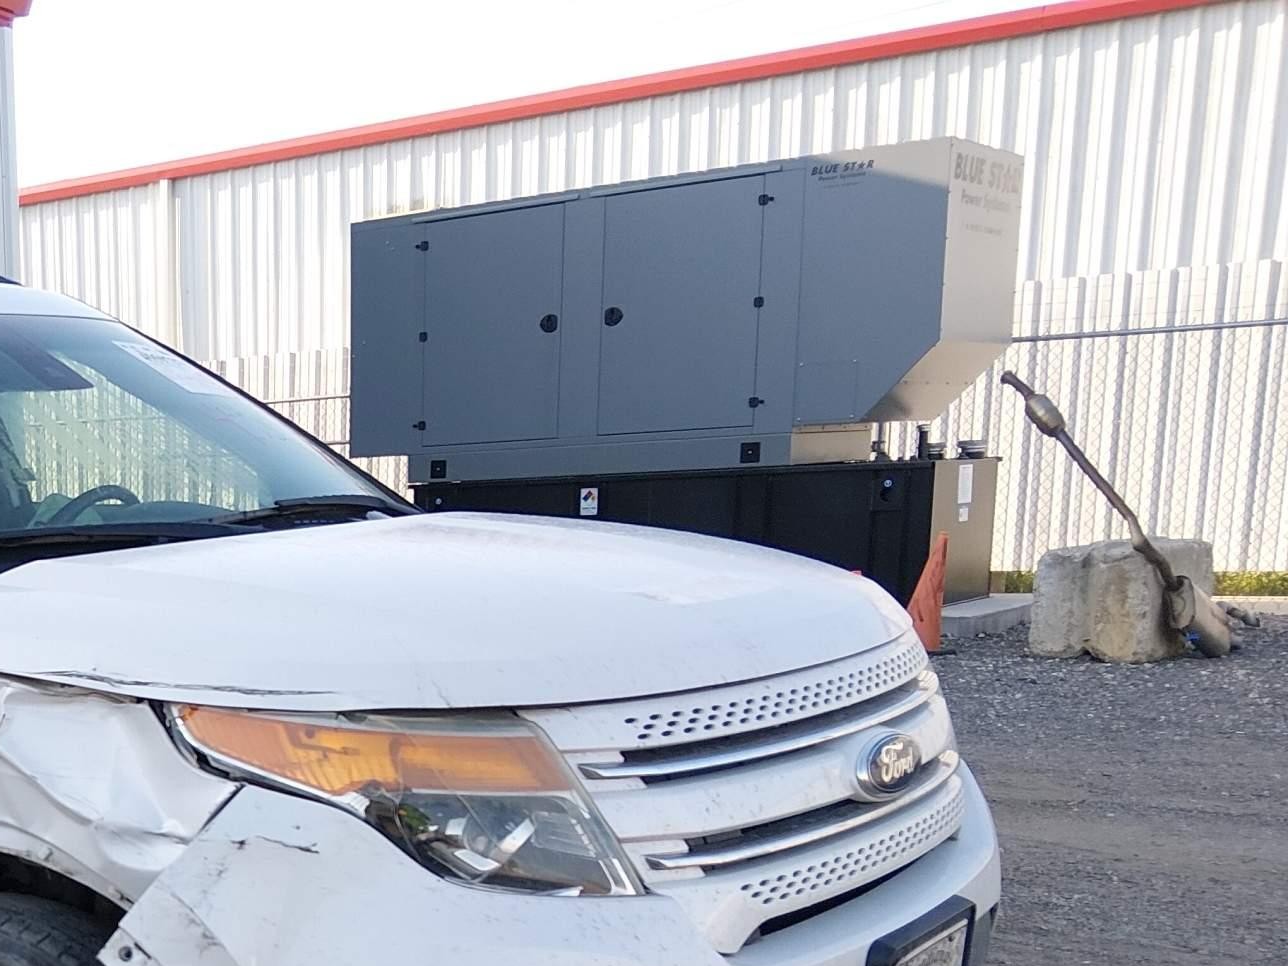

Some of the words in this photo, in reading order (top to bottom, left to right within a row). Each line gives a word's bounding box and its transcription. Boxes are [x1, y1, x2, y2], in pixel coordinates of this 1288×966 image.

[811, 164, 840, 176] BLUE
[954, 152, 986, 185] BLUE
[877, 742, 914, 783] Ford
